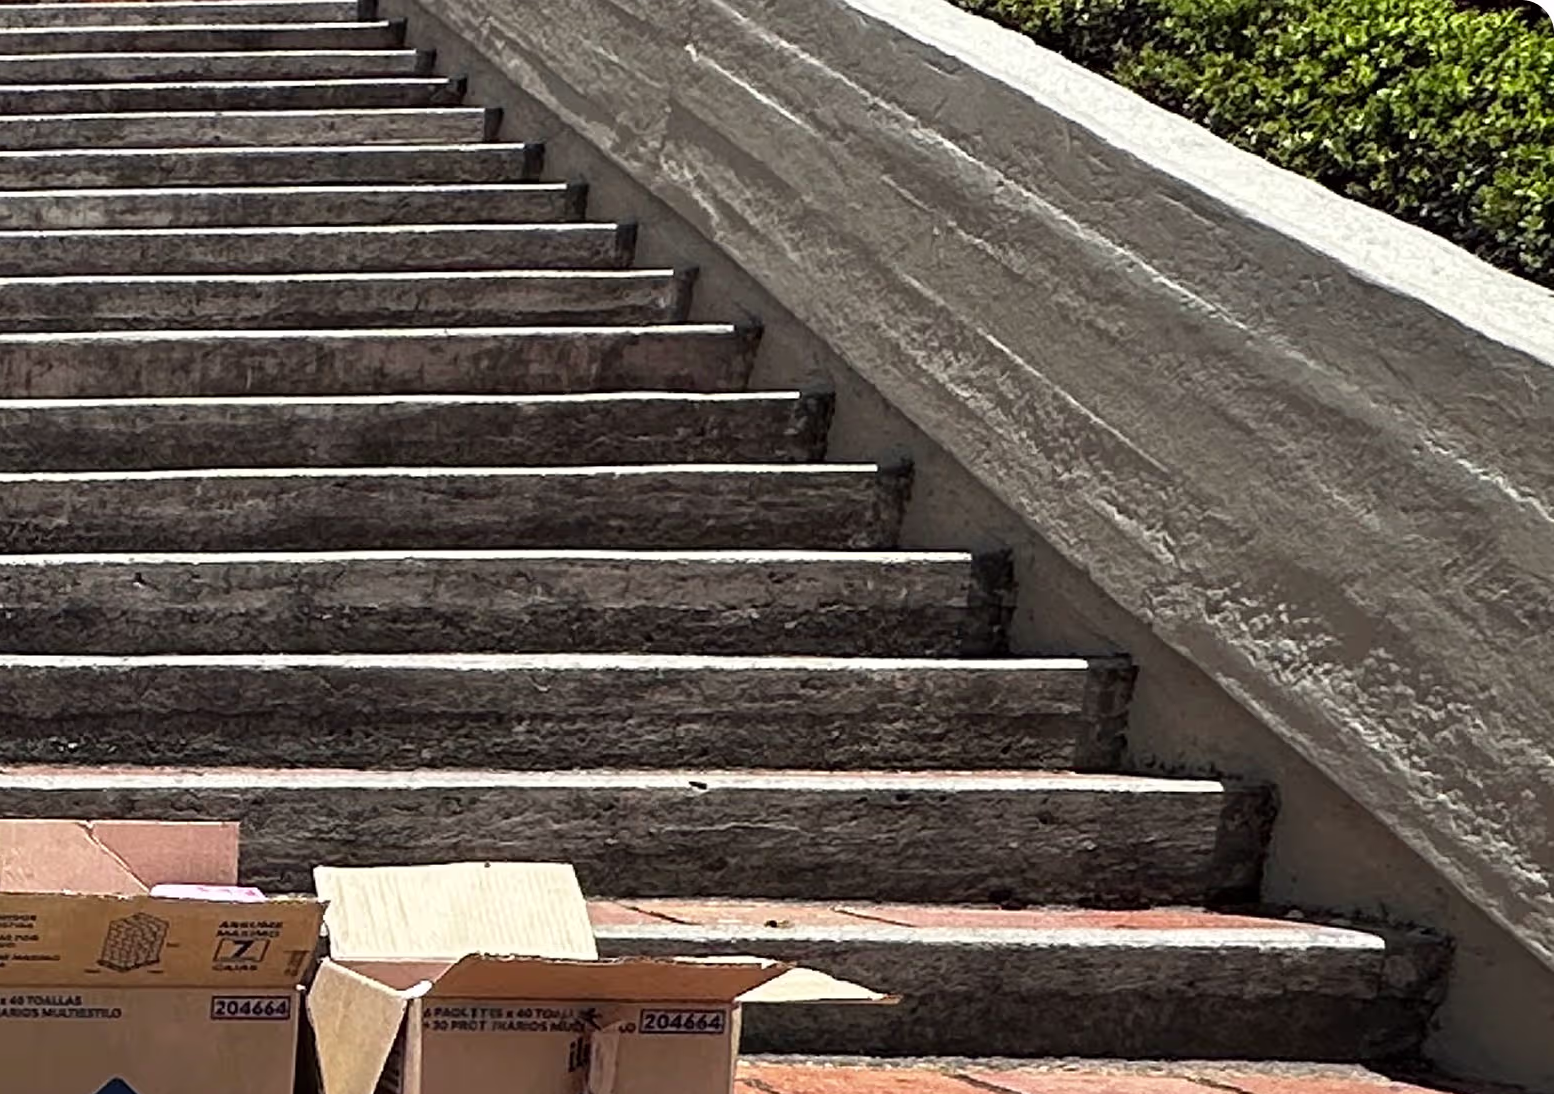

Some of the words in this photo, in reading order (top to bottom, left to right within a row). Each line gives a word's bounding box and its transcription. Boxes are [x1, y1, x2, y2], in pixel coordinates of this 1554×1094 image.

[231, 940, 254, 960] 7
[27, 996, 82, 1006] TOALLAS
[215, 1000, 287, 1016] 204664
[42, 1008, 122, 1019] MULTIESTILO
[644, 1014, 721, 1030] 204664
